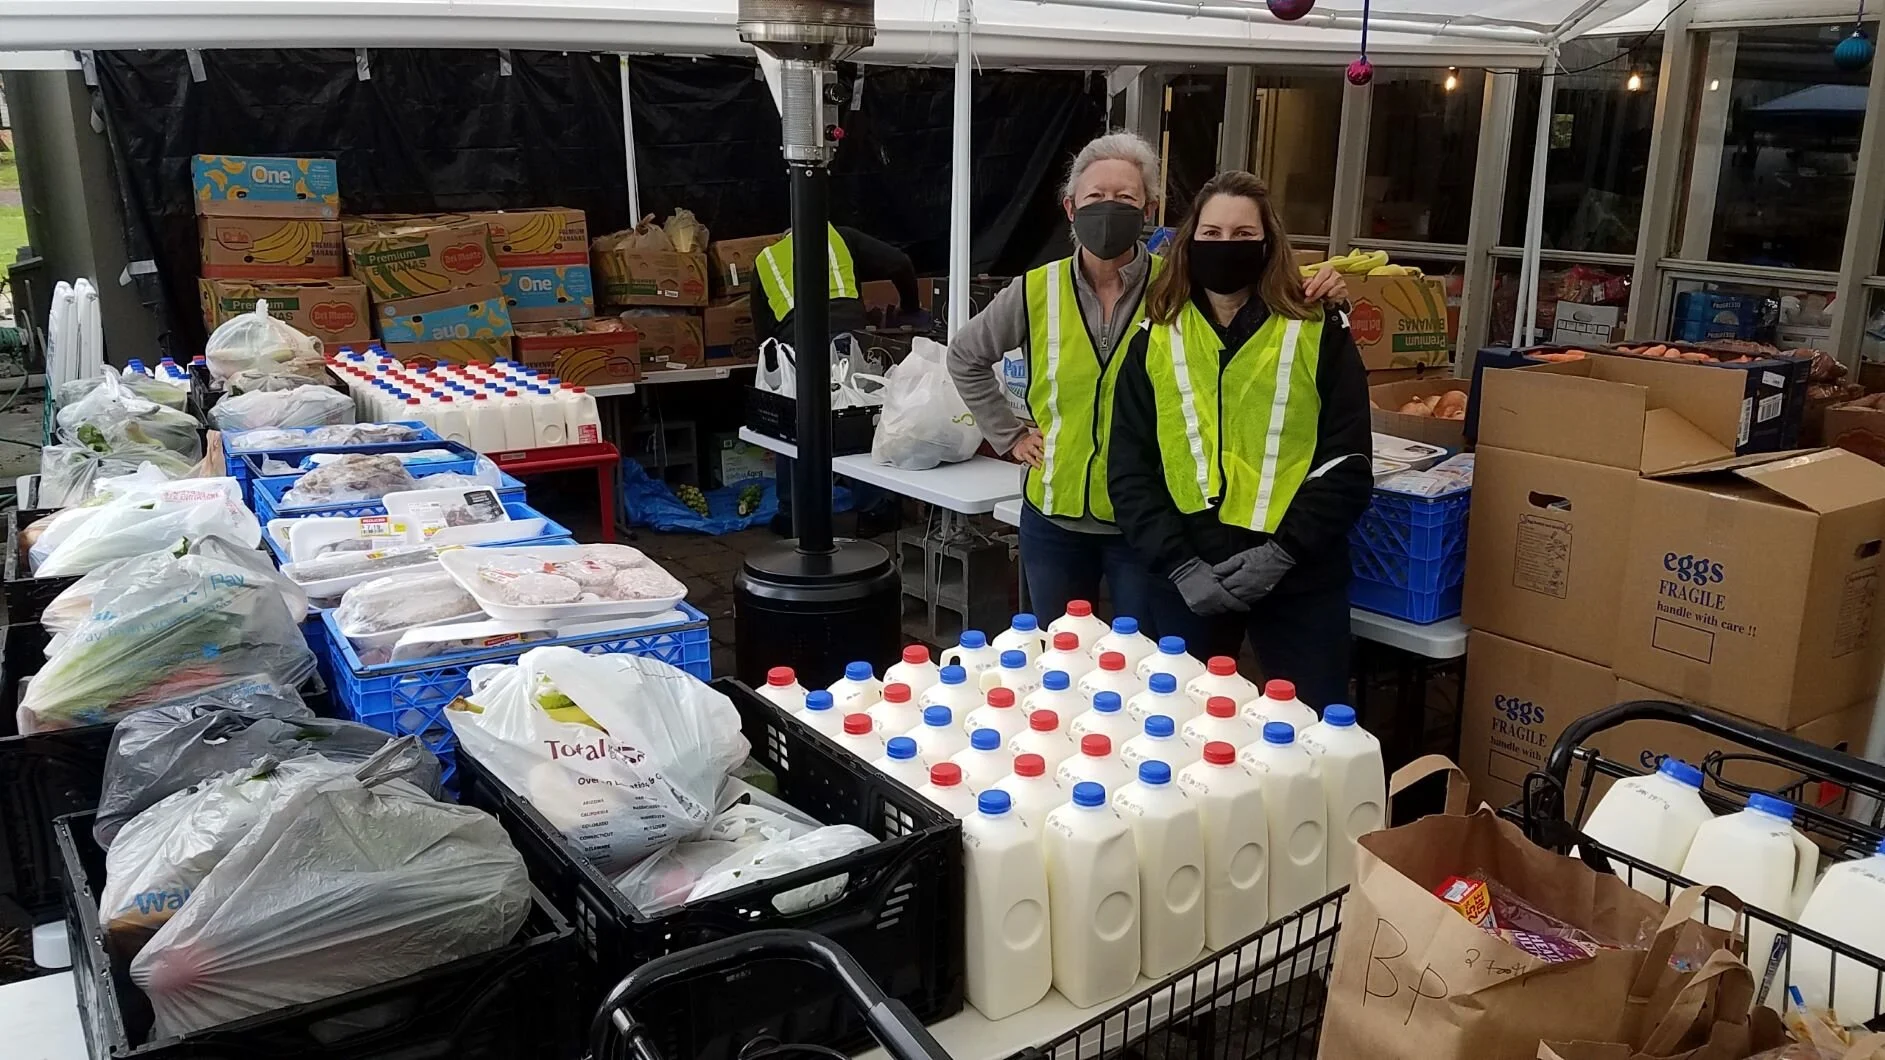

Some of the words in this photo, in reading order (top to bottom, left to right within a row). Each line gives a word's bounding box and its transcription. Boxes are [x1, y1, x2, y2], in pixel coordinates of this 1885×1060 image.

[251, 165, 291, 184] One
[368, 250, 416, 264] Premium
[518, 276, 553, 292] One
[232, 301, 284, 310] Premum
[314, 311, 328, 320] Del
[431, 323, 469, 340] One
[1405, 335, 1446, 348] Premium
[1663, 552, 1724, 586] eggs
[1659, 579, 1726, 611] FRAGILE
[1656, 600, 1692, 619] handle
[1695, 612, 1718, 627] with
[1720, 620, 1745, 634] care
[1494, 694, 1545, 725] eggs
[1492, 716, 1548, 748] FRAGILE
[544, 738, 606, 761] Total
[1490, 735, 1521, 753] handle
[1522, 747, 1541, 761] with
[135, 888, 191, 915] Wal
